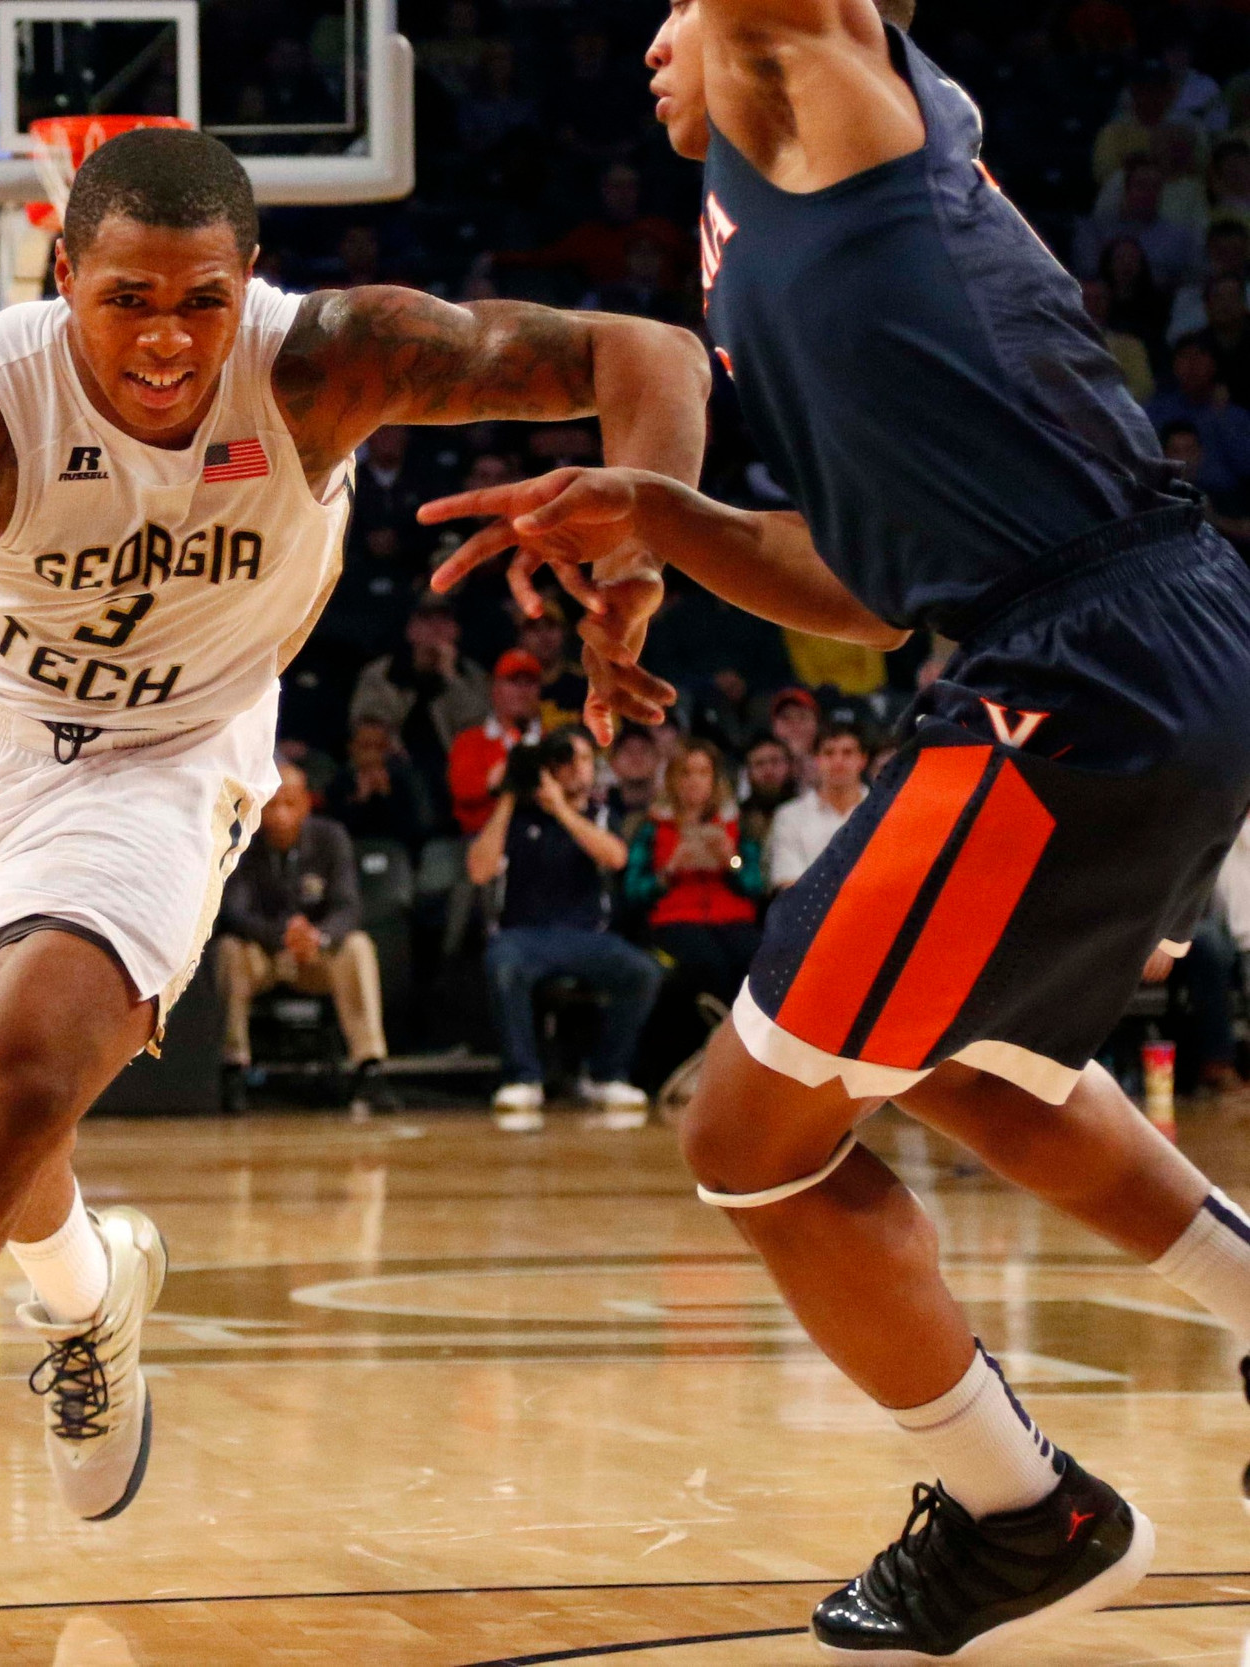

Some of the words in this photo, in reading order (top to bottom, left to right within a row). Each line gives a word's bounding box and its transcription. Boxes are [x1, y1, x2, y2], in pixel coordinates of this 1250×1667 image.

[58, 471, 110, 483] RUSSELL
[66, 446, 102, 471] R
[34, 521, 264, 590] GEORGIA
[72, 591, 157, 648] 3
[980, 696, 1052, 750] V
